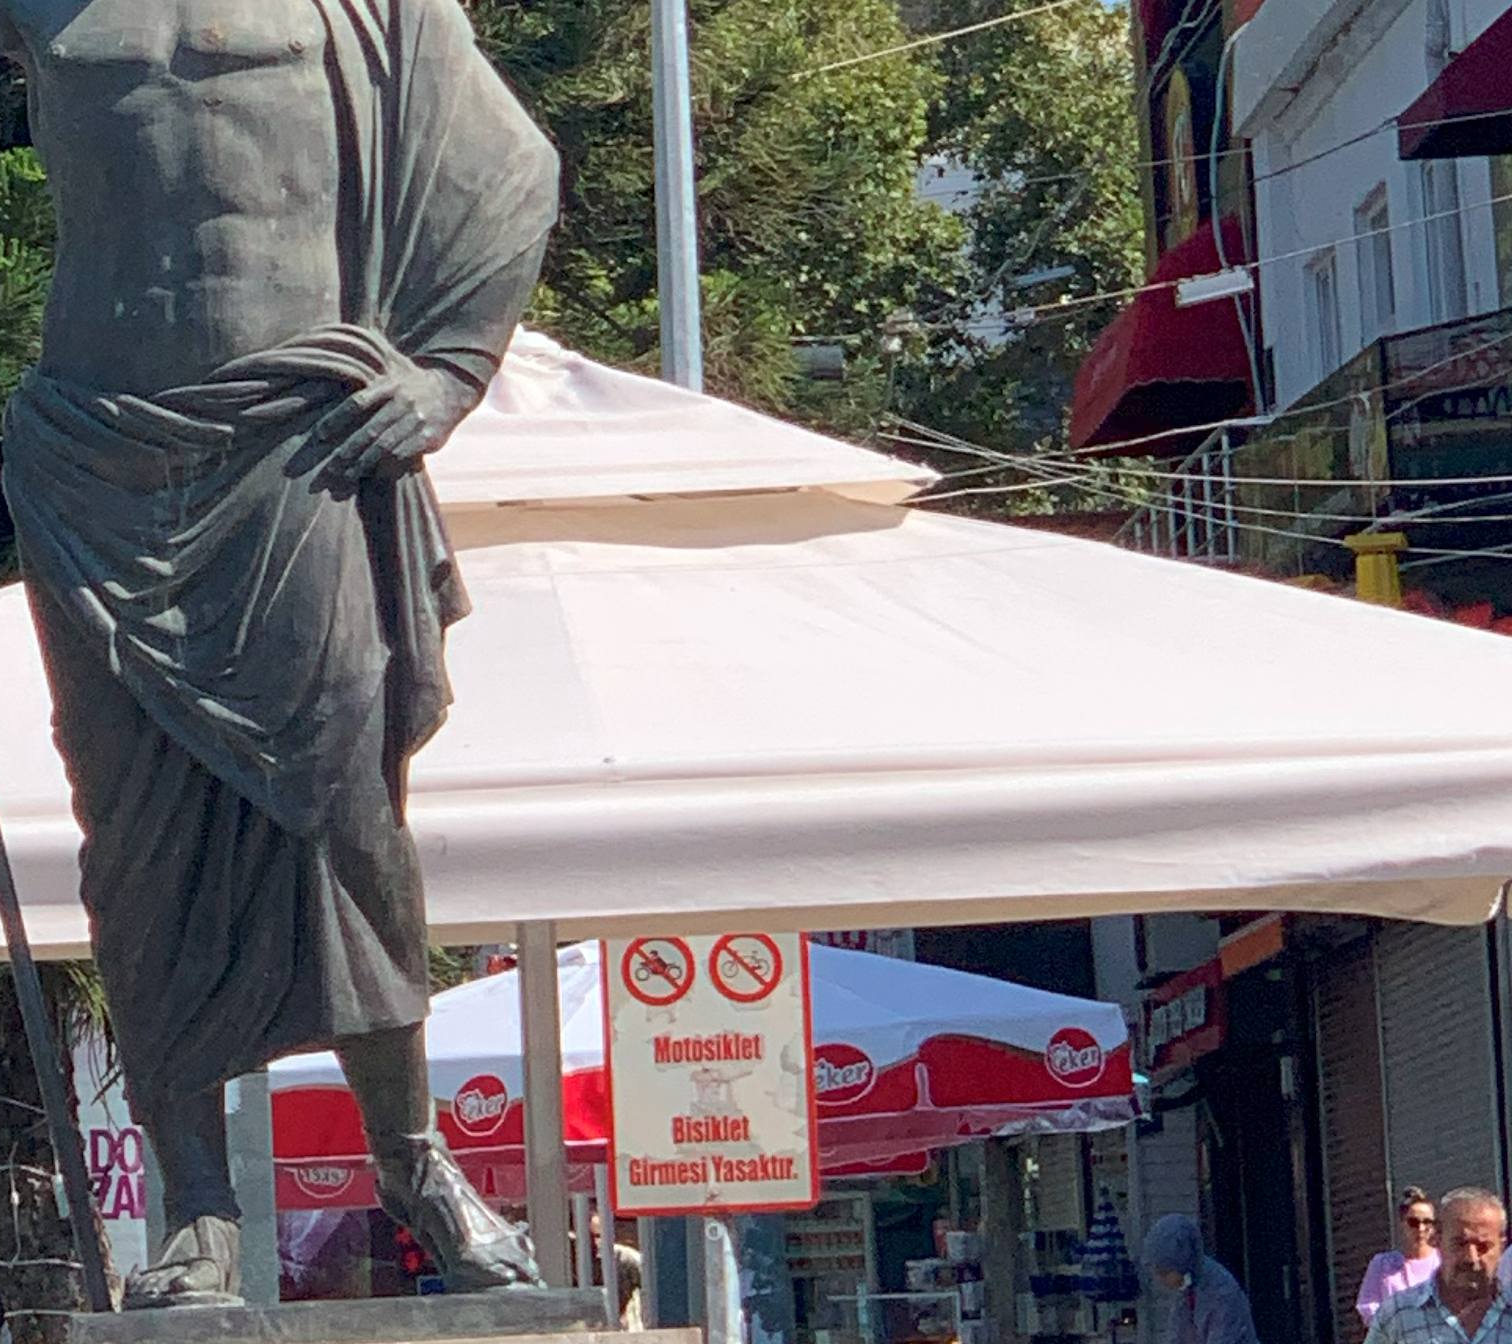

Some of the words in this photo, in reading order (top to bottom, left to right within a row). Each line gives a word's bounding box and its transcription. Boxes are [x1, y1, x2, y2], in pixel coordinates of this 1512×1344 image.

[653, 1033, 763, 1064] Motosiklet
[672, 1115, 751, 1145] Bisiklet
[629, 1155, 708, 1187] Girmesi
[712, 1152, 798, 1184] Yasaktır.
